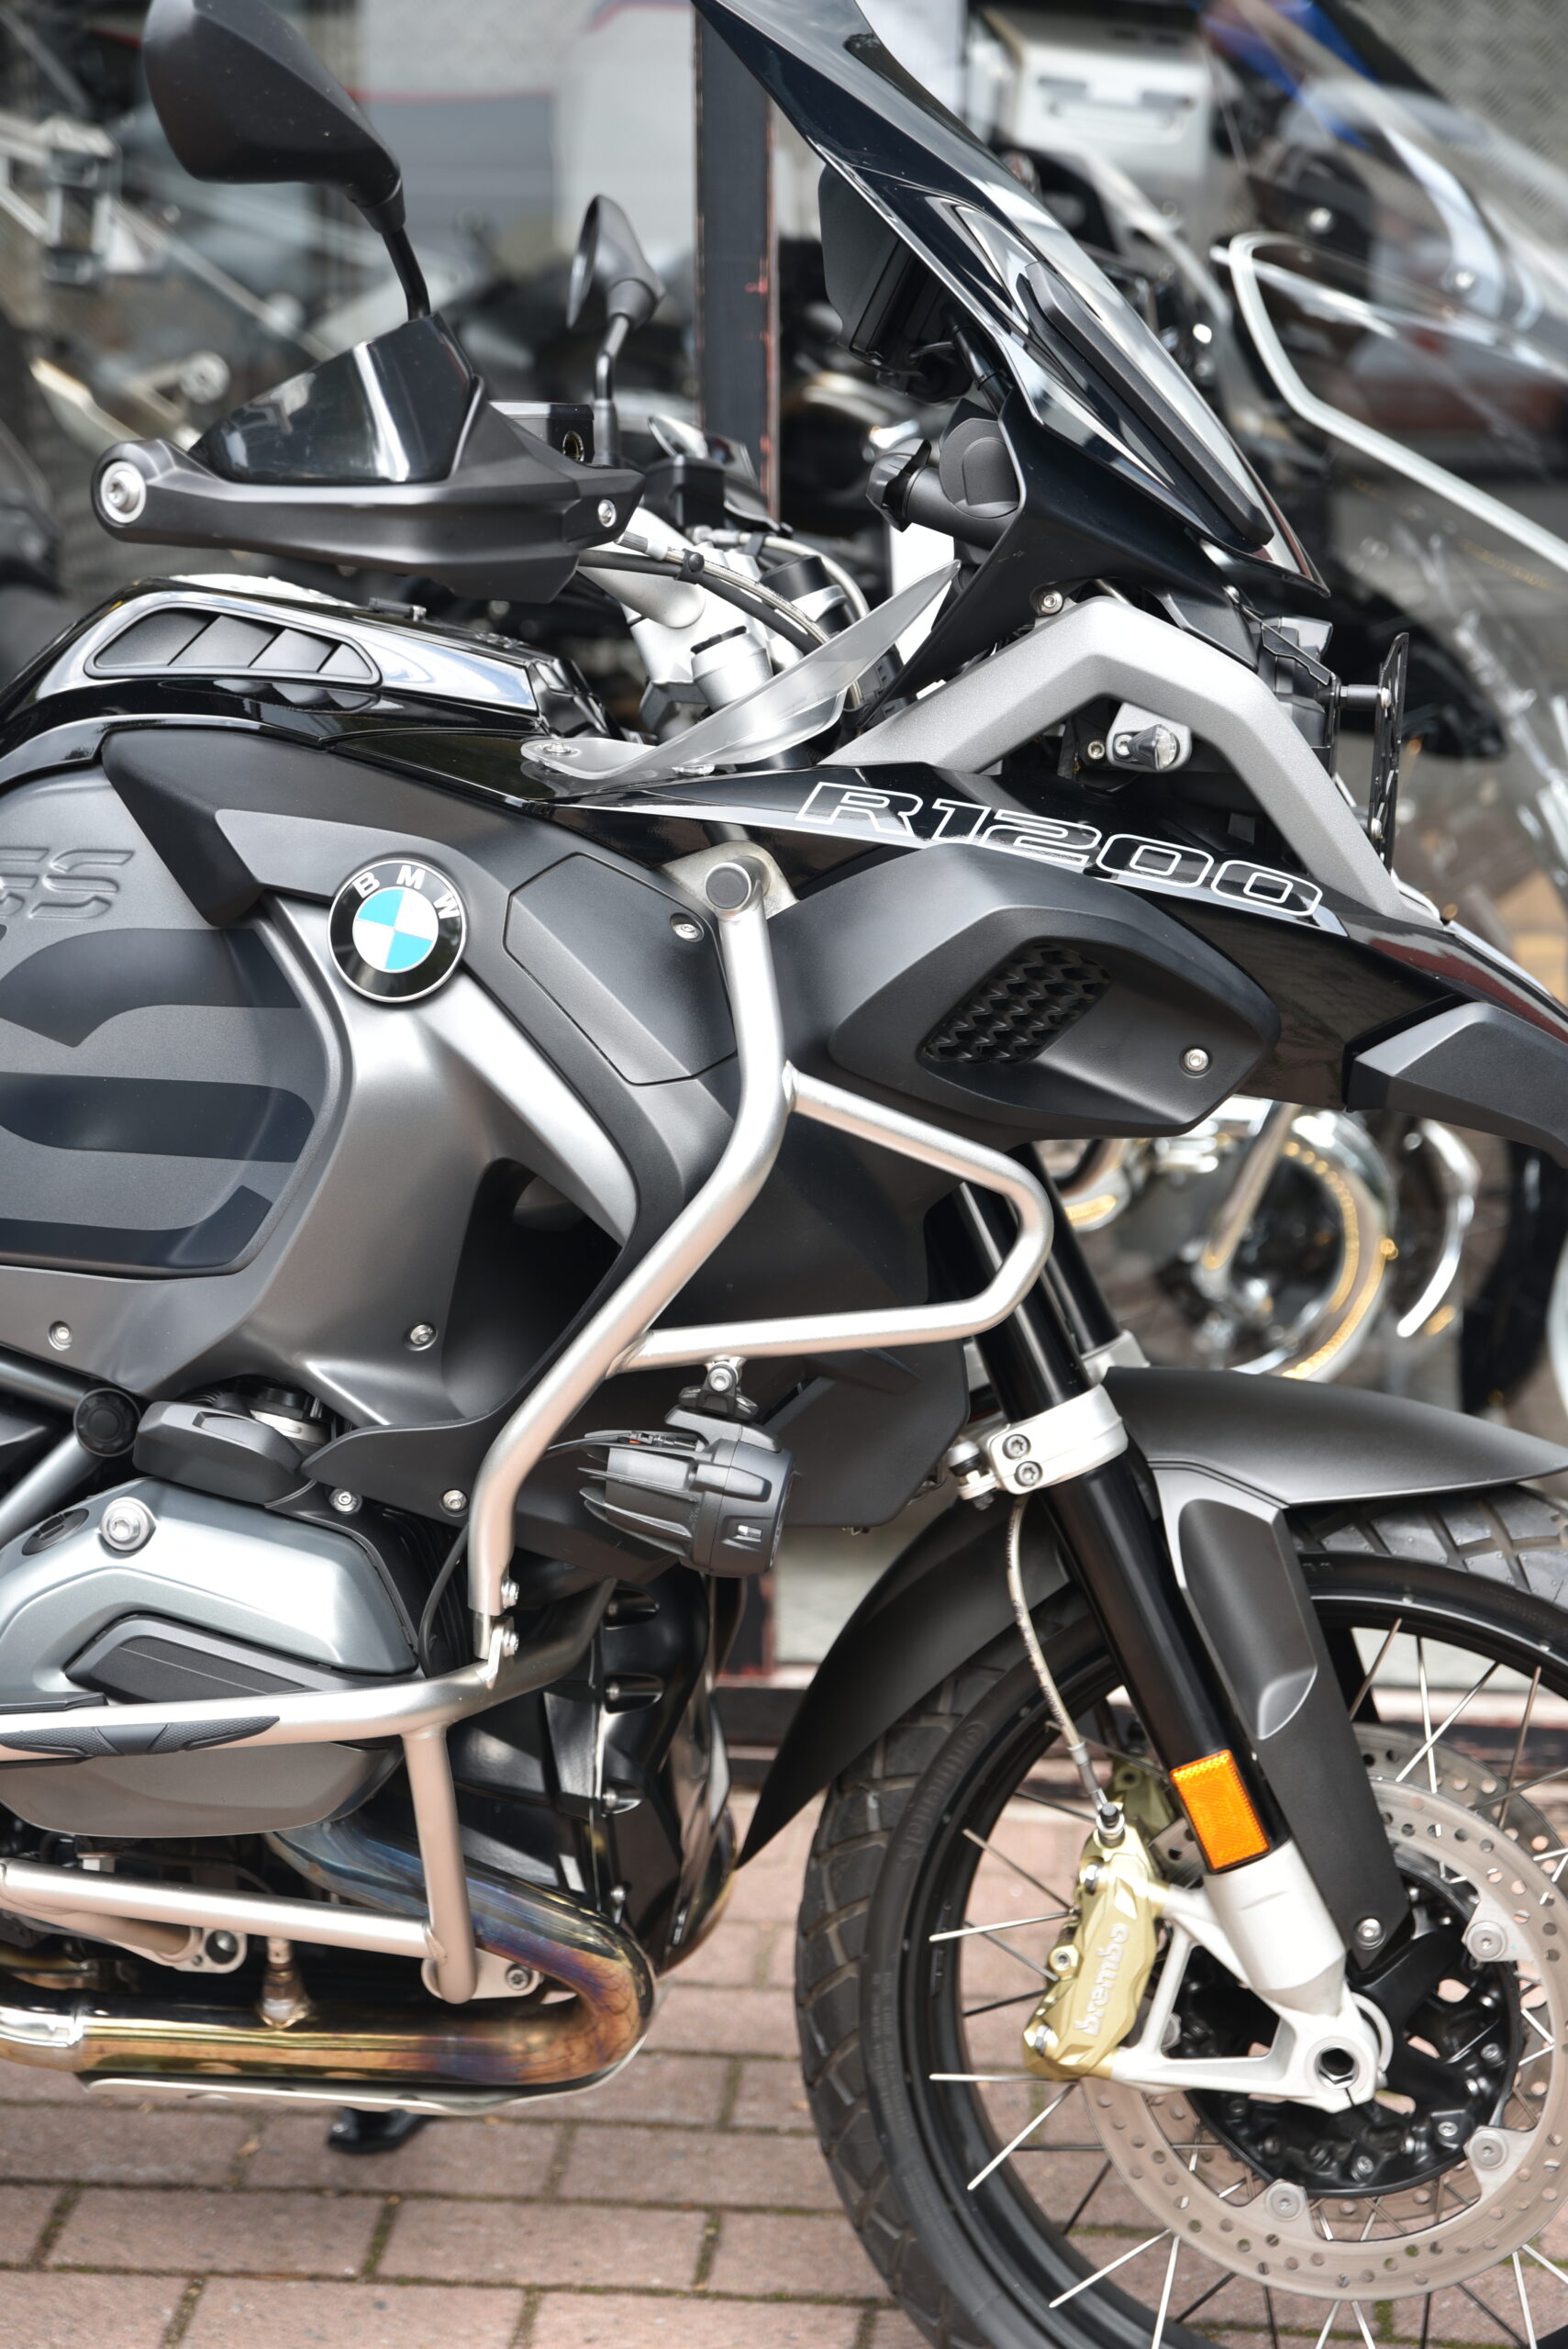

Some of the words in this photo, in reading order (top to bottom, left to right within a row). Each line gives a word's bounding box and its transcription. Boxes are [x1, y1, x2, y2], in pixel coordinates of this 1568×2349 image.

[352, 864, 461, 918] BMW
[795, 781, 1323, 916] R1200
[1073, 1922, 1129, 2036] brembo
